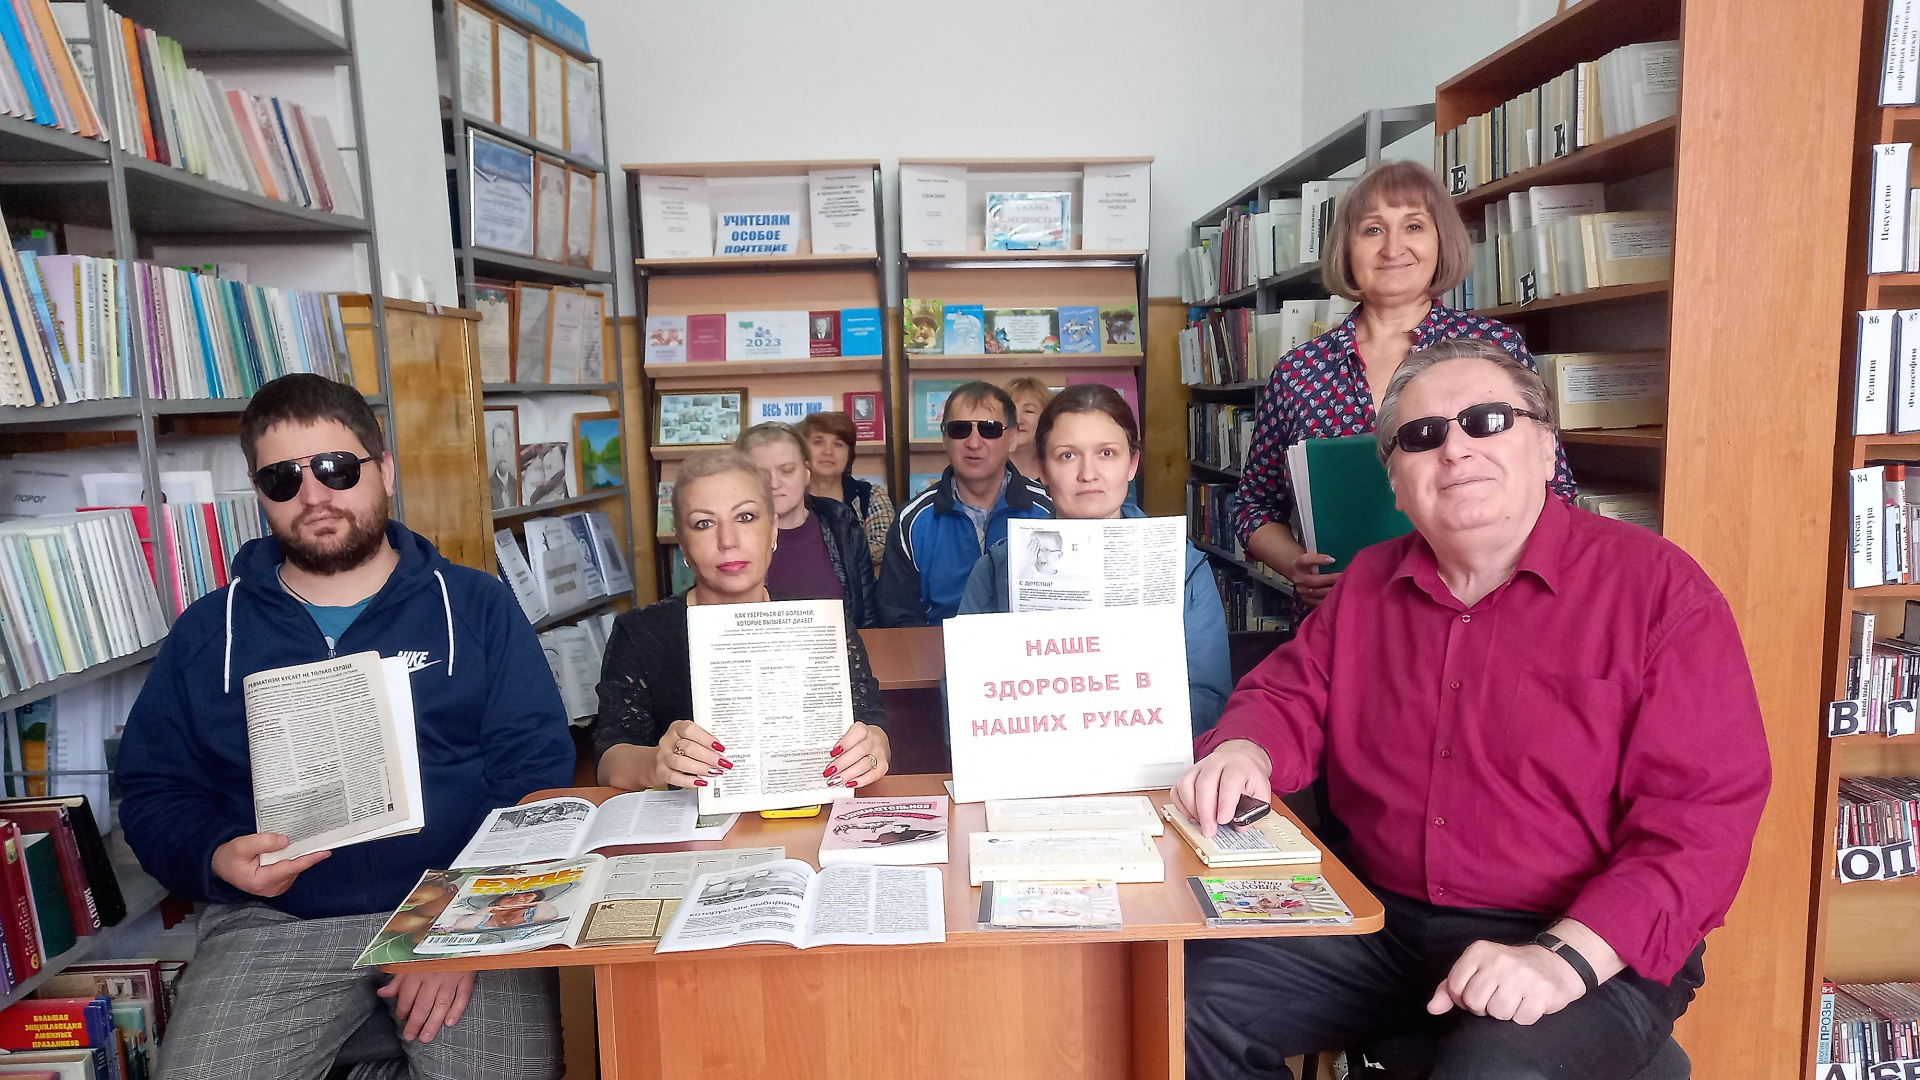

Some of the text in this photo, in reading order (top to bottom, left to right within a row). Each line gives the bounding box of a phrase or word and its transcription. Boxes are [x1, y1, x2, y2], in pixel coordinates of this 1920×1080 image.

[1884, 147, 1896, 156] 85
[1450, 166, 1468, 194] Е
[1880, 184, 1892, 241] Искусство
[723, 214, 791, 227] УЧИТЕЛЯМ
[731, 230, 781, 242] ОСОБОЕ
[724, 243, 788, 254] ПОЧТЕНИЕ
[1868, 316, 1880, 325] 86
[1908, 313, 1918, 322] 87
[745, 338, 782, 348] 2023
[1865, 359, 1877, 403] Религия
[762, 403, 781, 417] ВЕСЬ
[784, 402, 803, 416] ЭТОТ
[1857, 474, 1868, 483] 84
[14, 493, 47, 503] ПОРОГ
[1865, 507, 1875, 564] литература
[747, 611, 778, 619] УБЕРЕЧЬСЯ
[762, 618, 792, 626] ВЫЗЫВАЕТ
[792, 617, 813, 625] ДИАБЕТ
[1025, 636, 1101, 656] НАШЕ
[247, 677, 280, 689] РЕВМАТИЗМ
[281, 673, 301, 682] КУСАЕТ
[310, 667, 333, 676] ТОЛЬКО
[332, 663, 352, 673] СЕРДЦЕ
[984, 672, 1152, 701] ЗДОРОВЬЕ В
[972, 707, 1163, 736] НАШИХ РУКАХ
[1830, 701, 1859, 736] В
[1888, 701, 1914, 735] Г
[1841, 848, 1880, 880] О
[1882, 841, 1916, 878] П
[689, 908, 731, 918] которую
[33, 1014, 69, 1022] БОЛЬШАЯ
[1820, 1000, 1832, 1041] ПРОЗЫ
[25, 1022, 83, 1032] ЭНЦИКЛОПЕДИЯ
[34, 1031, 73, 1039] ЛЮБИМЫХ
[32, 1040, 80, 1048] ПРАЗДНИКОВ
